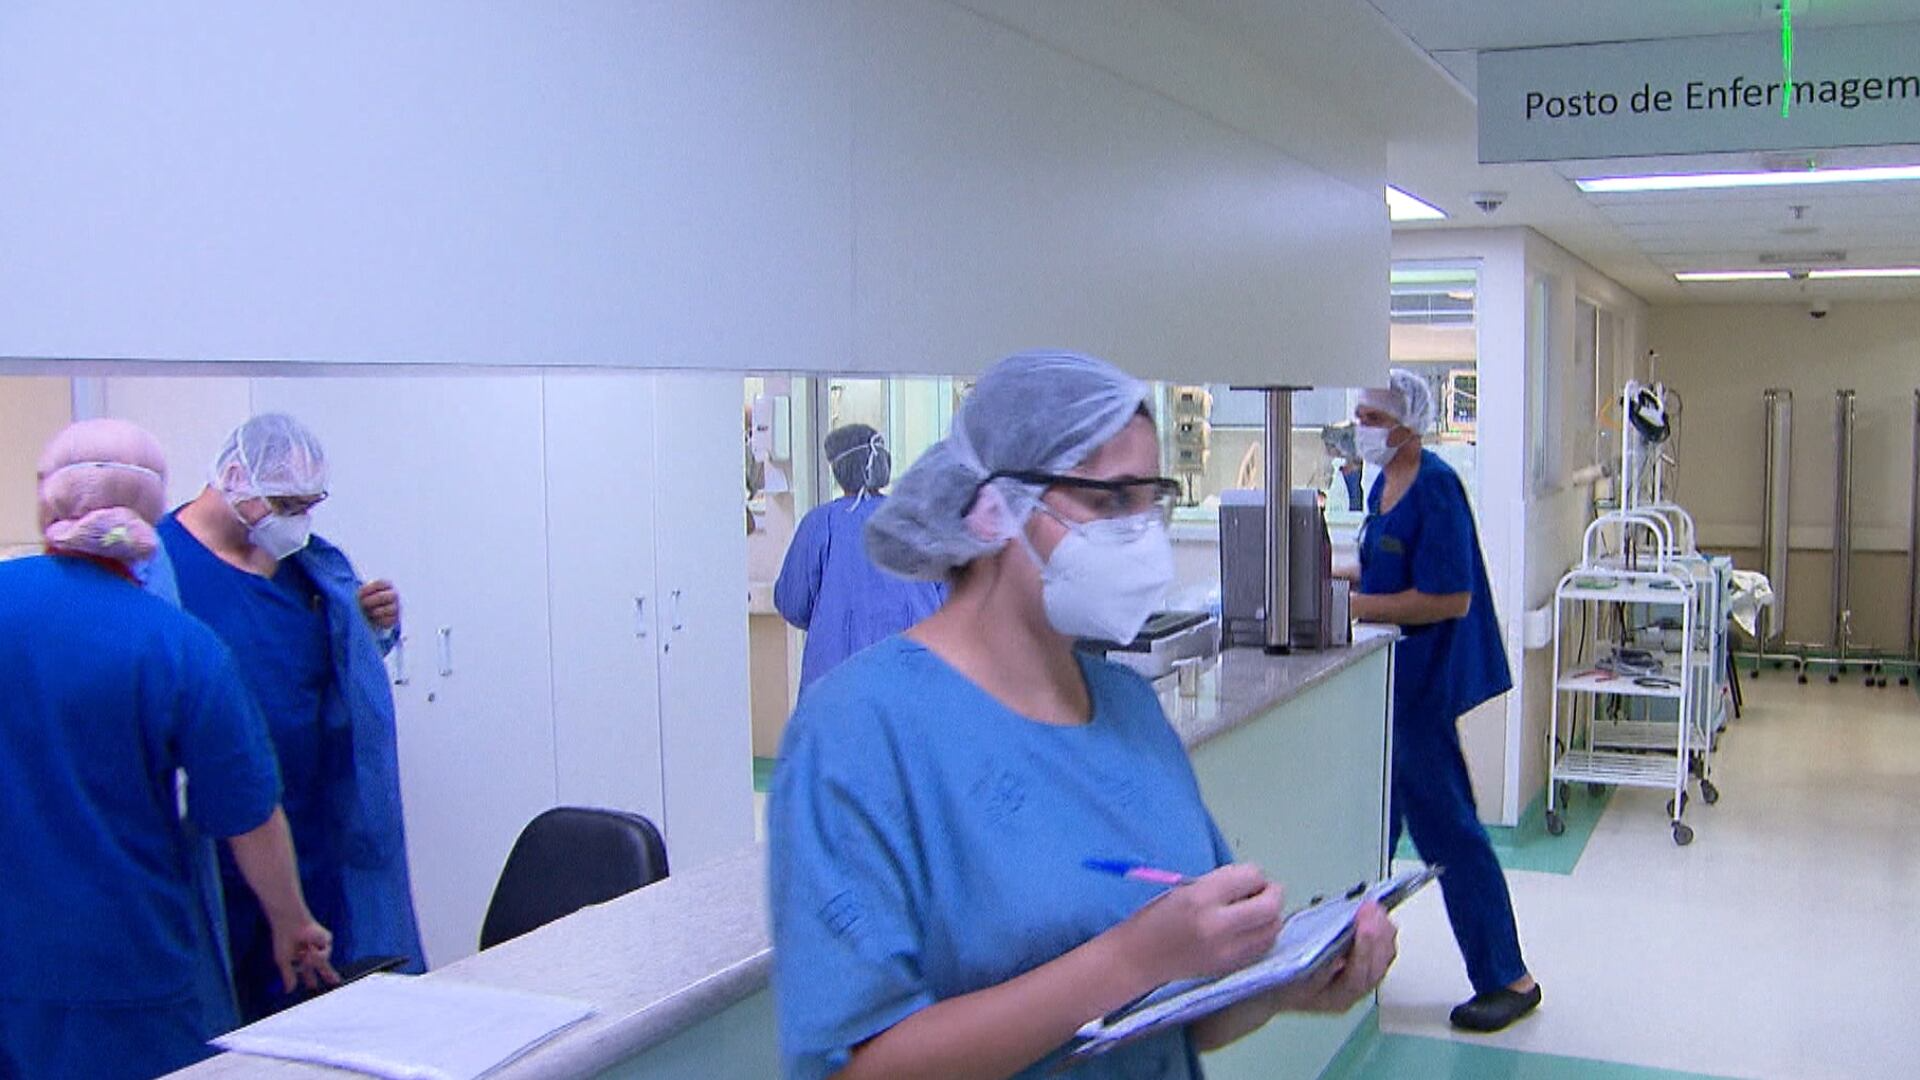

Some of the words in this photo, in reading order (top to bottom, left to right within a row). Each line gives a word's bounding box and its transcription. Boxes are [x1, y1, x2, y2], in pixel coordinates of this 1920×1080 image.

[1526, 91, 1618, 120] Posto
[1630, 82, 1673, 114] de
[1686, 76, 1920, 111] Enfermagem
